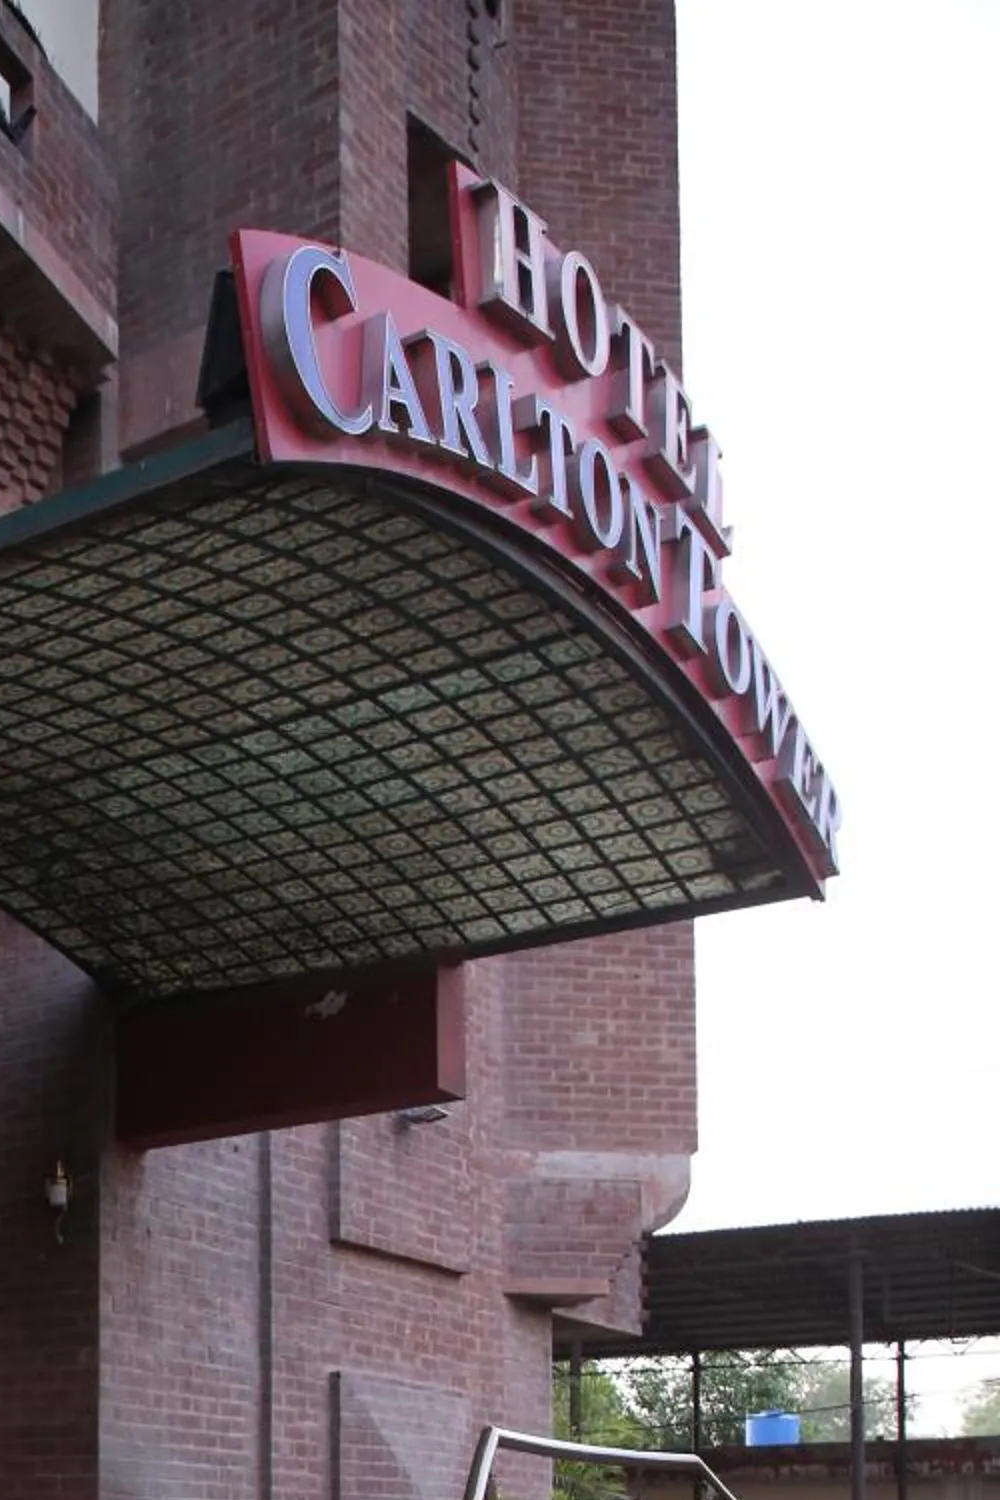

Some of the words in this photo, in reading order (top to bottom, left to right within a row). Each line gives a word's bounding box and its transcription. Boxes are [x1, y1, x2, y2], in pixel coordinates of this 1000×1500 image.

[274, 245, 662, 604] CARLTON
[676, 502, 842, 876] TOWER
[474, 177, 734, 557] HOTEL
